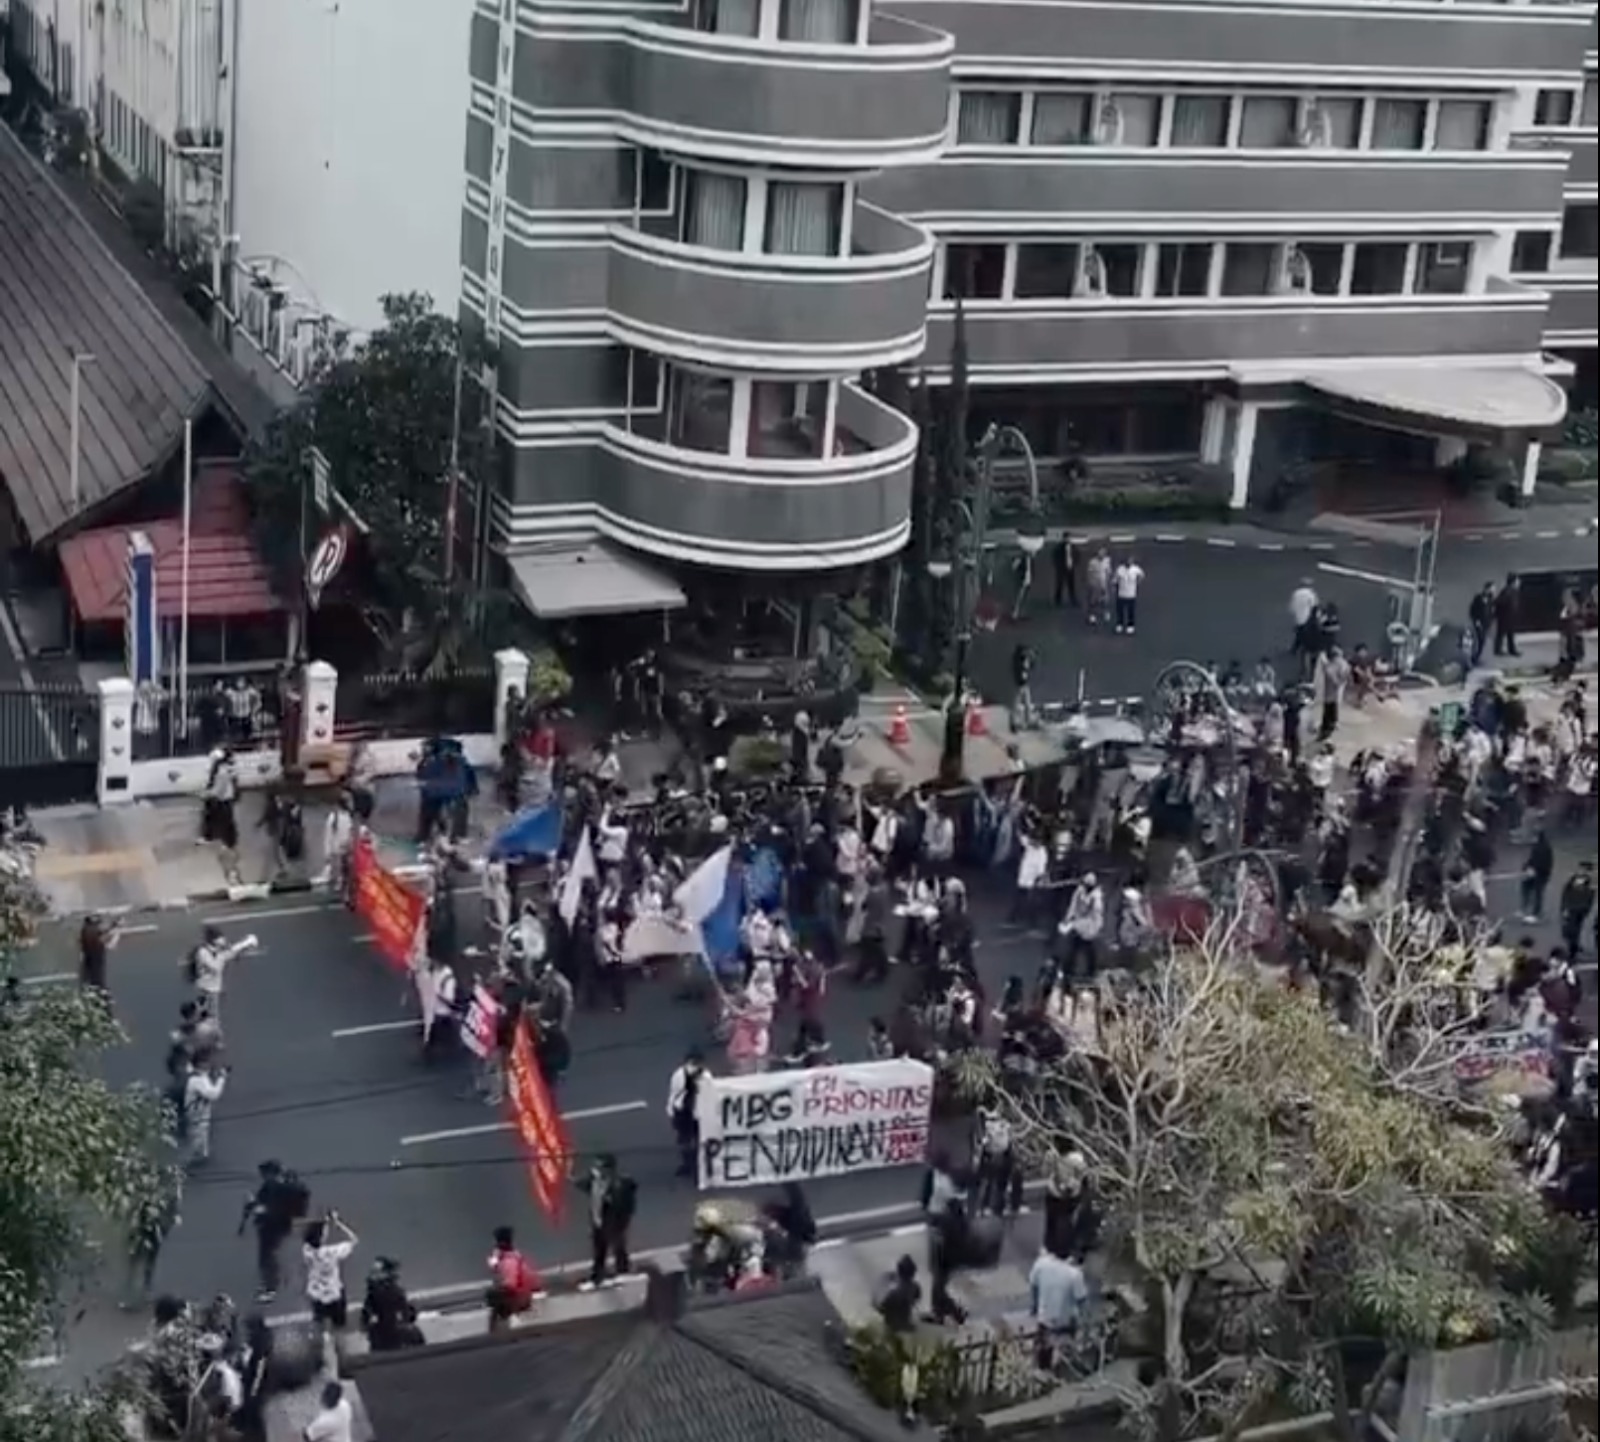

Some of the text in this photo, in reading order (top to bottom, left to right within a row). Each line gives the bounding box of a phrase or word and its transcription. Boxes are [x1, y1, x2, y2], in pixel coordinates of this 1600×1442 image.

[722, 1084, 929, 1129] MBG PRIORITAS
[704, 1119, 885, 1180] PENDIDIKAN
